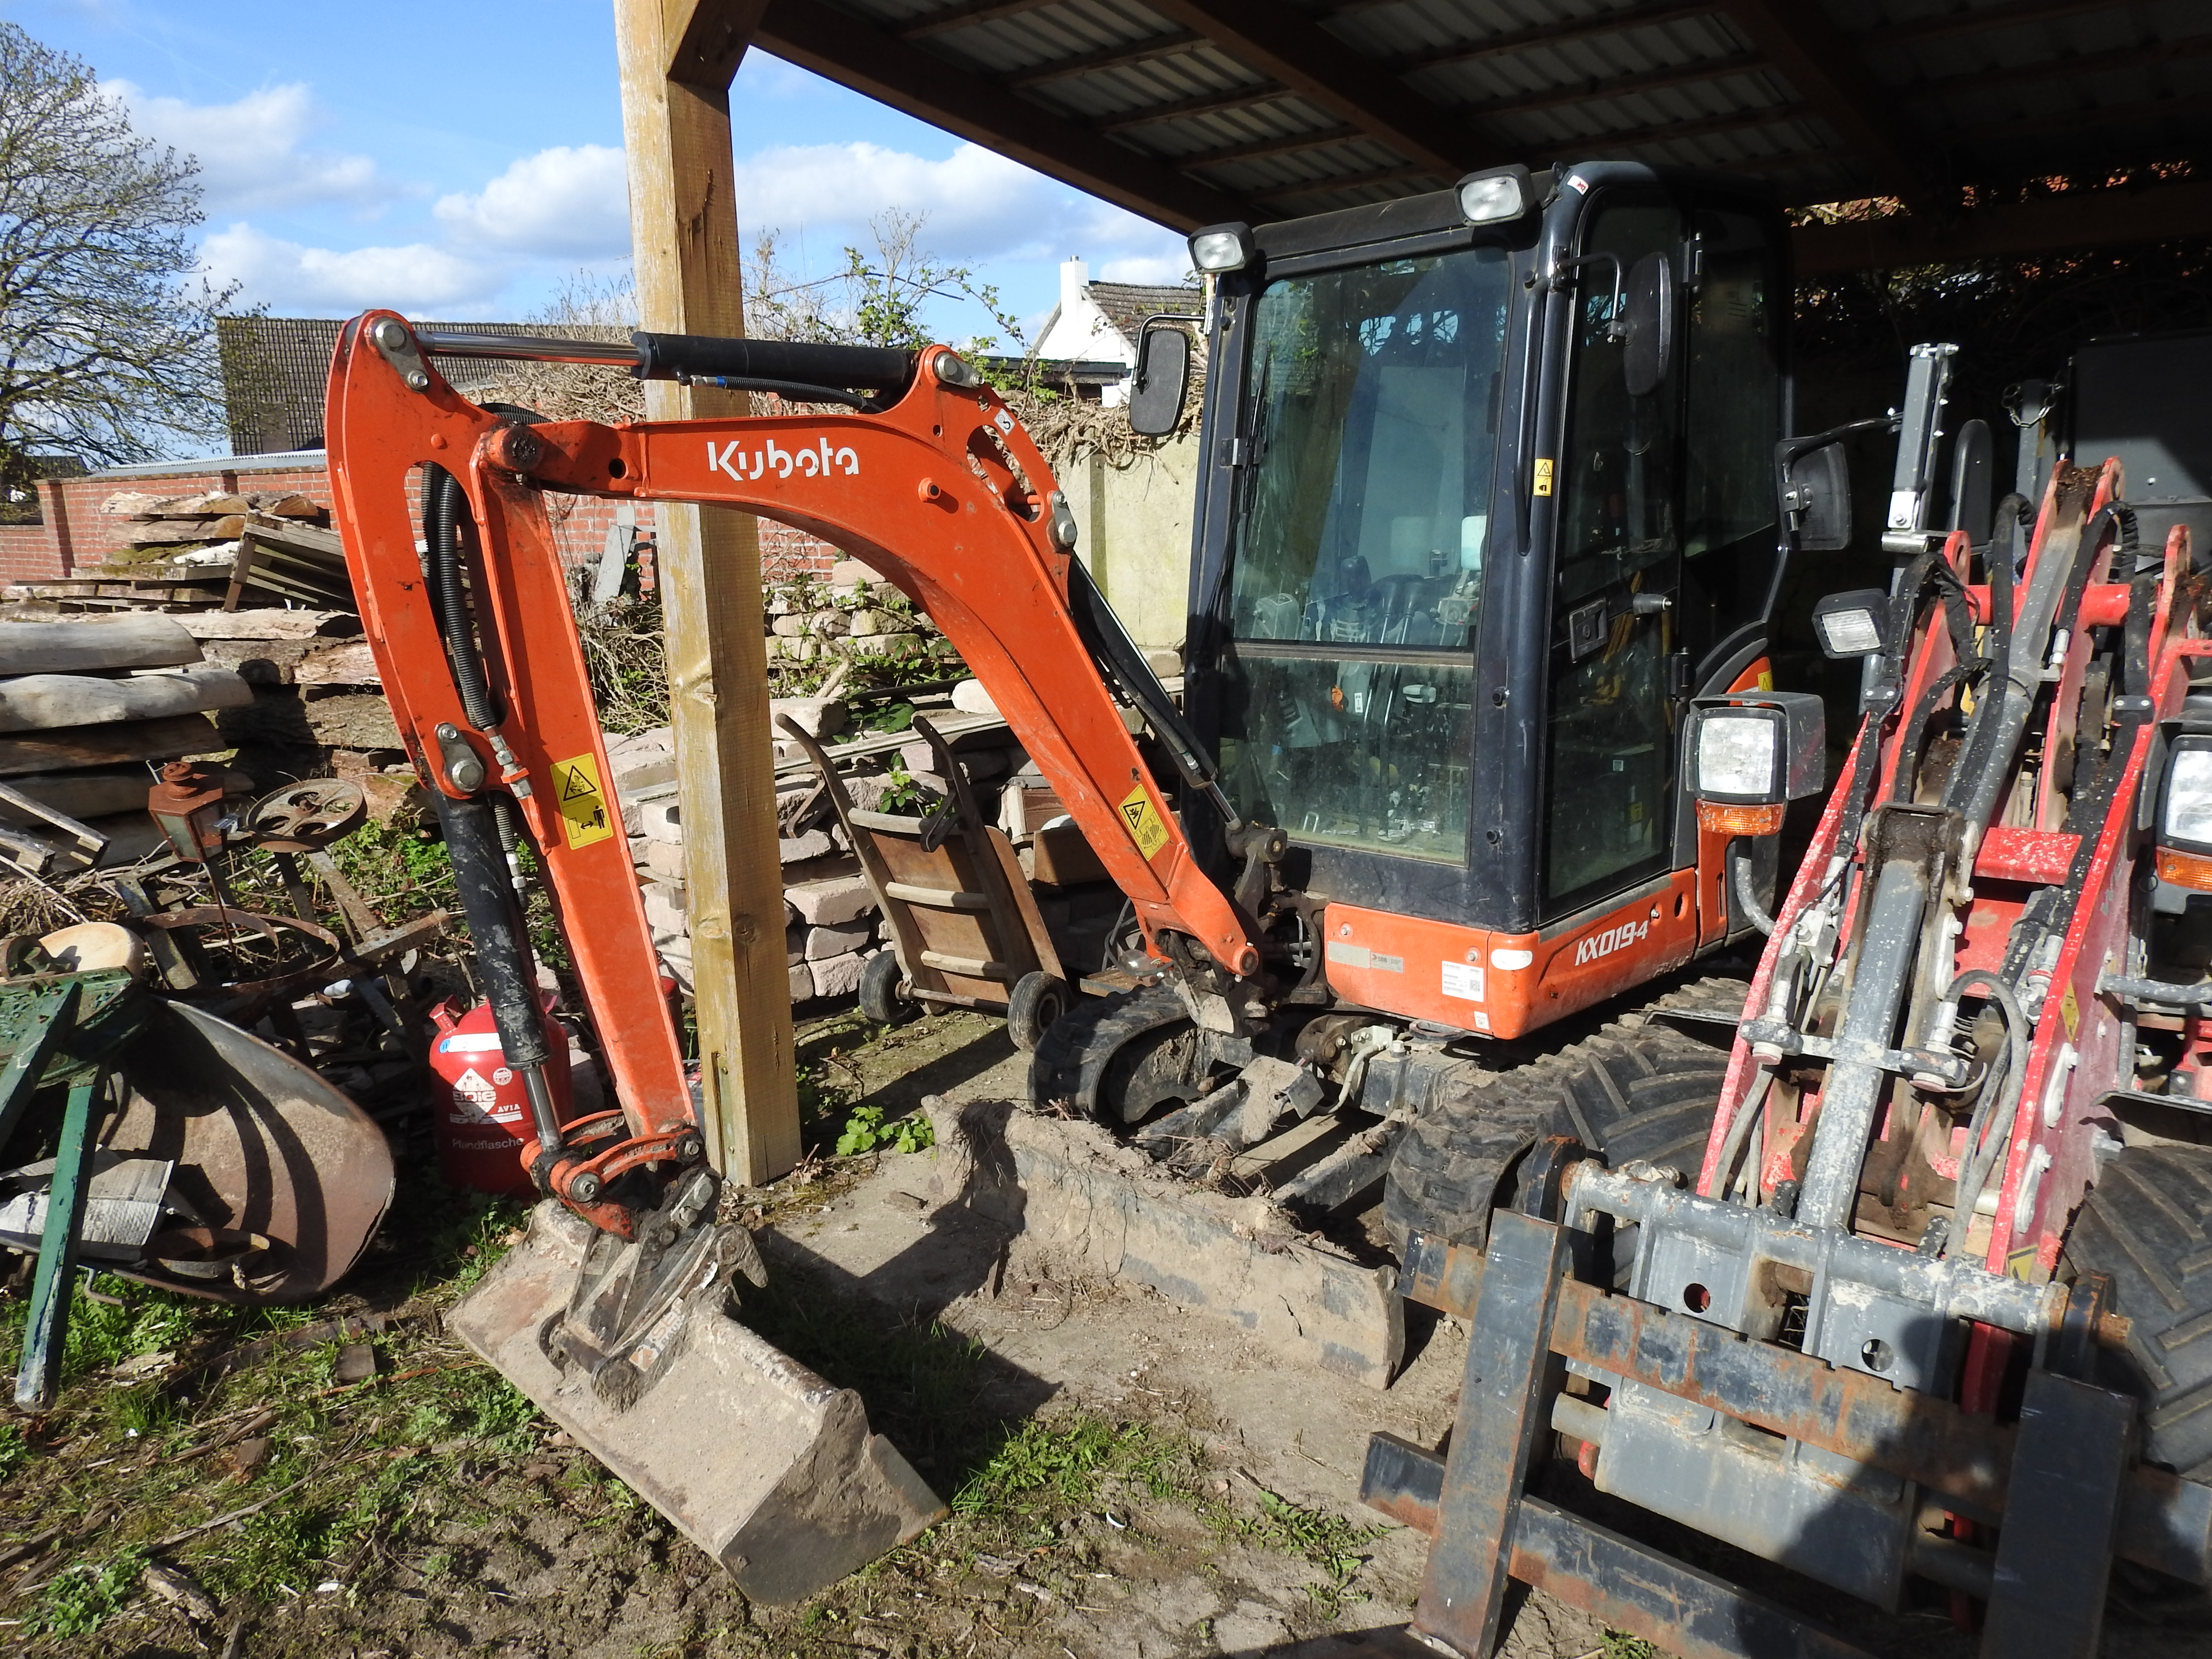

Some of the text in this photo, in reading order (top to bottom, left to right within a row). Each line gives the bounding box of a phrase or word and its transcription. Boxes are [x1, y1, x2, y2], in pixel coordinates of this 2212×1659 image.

[707, 437, 859, 481] Kubota
[1574, 920, 1648, 966] KX019-4
[497, 1104, 521, 1113] AVIA
